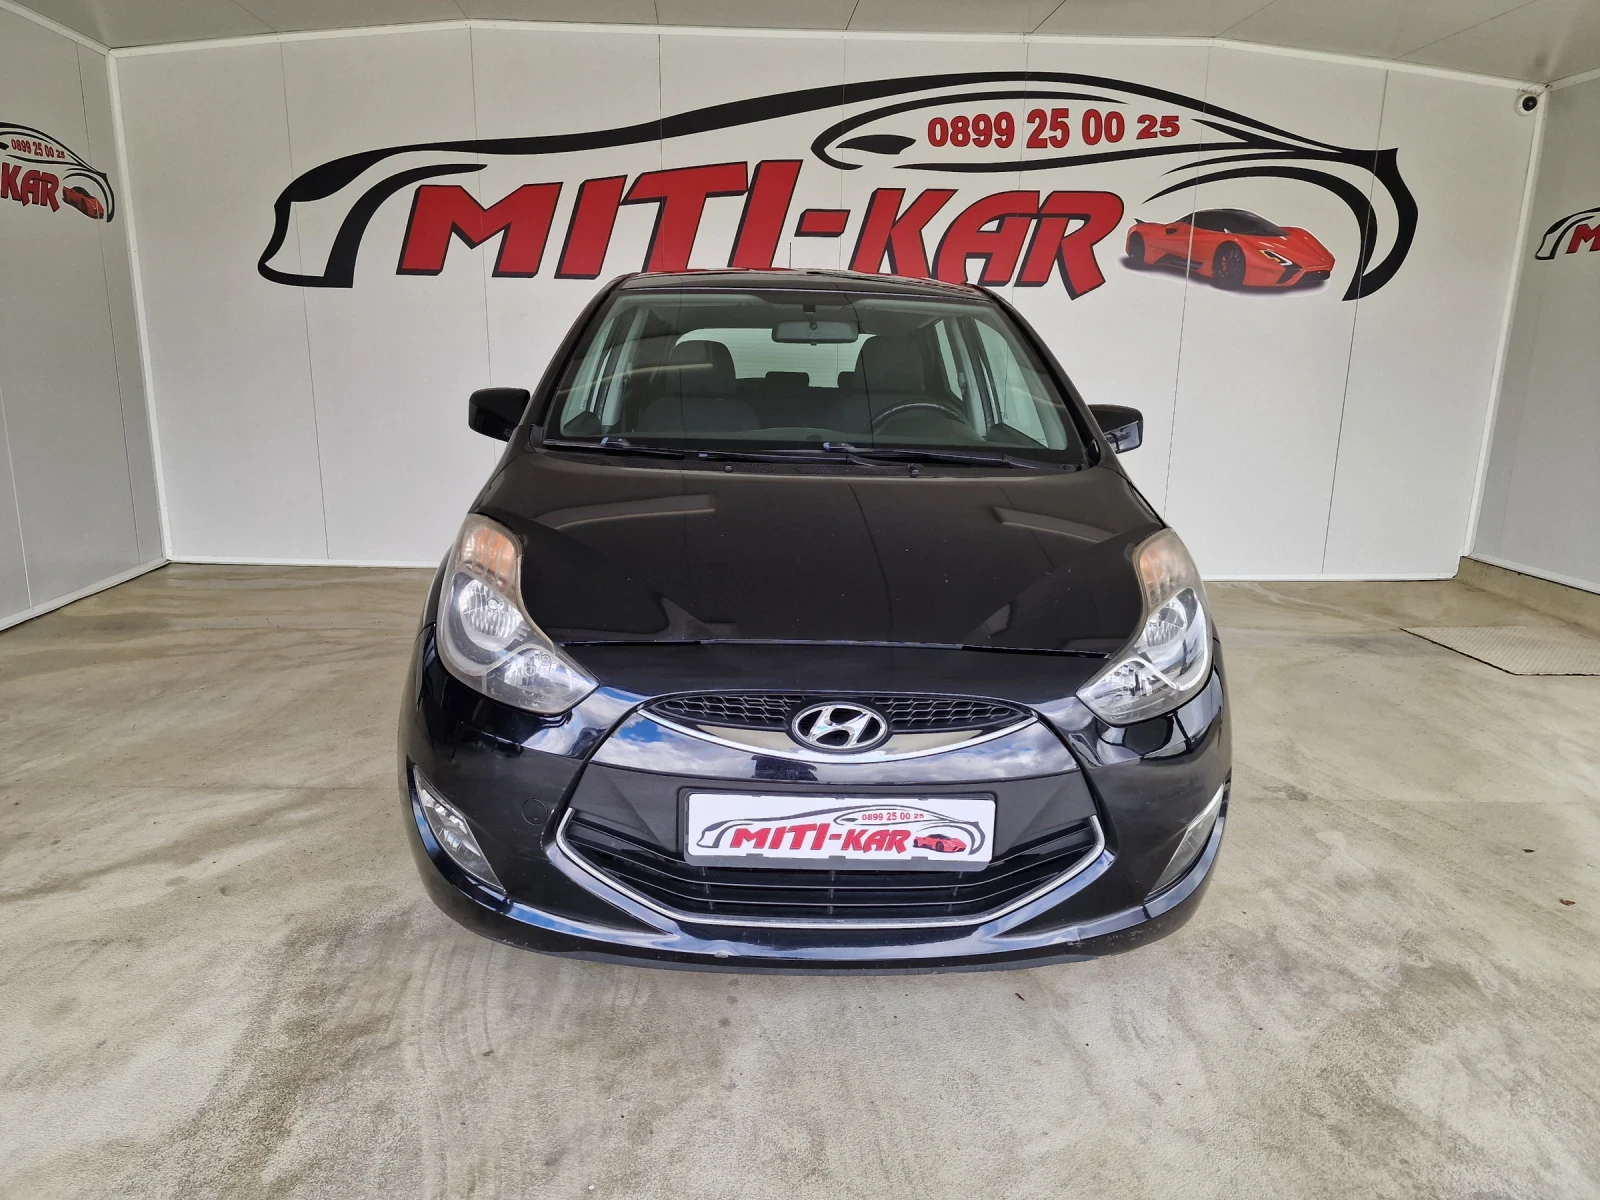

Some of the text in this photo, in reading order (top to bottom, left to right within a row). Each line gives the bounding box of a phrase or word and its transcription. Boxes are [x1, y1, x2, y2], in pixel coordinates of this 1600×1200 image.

[927, 108, 1181, 149] 0899 25 00 25
[11, 139, 65, 158] 0899 25 00 25
[396, 158, 1125, 301] MITI-KAR
[861, 812, 884, 822] 0899
[886, 811, 898, 821] 25
[899, 812, 911, 821] 00
[729, 823, 911, 854] MITI-KAR
